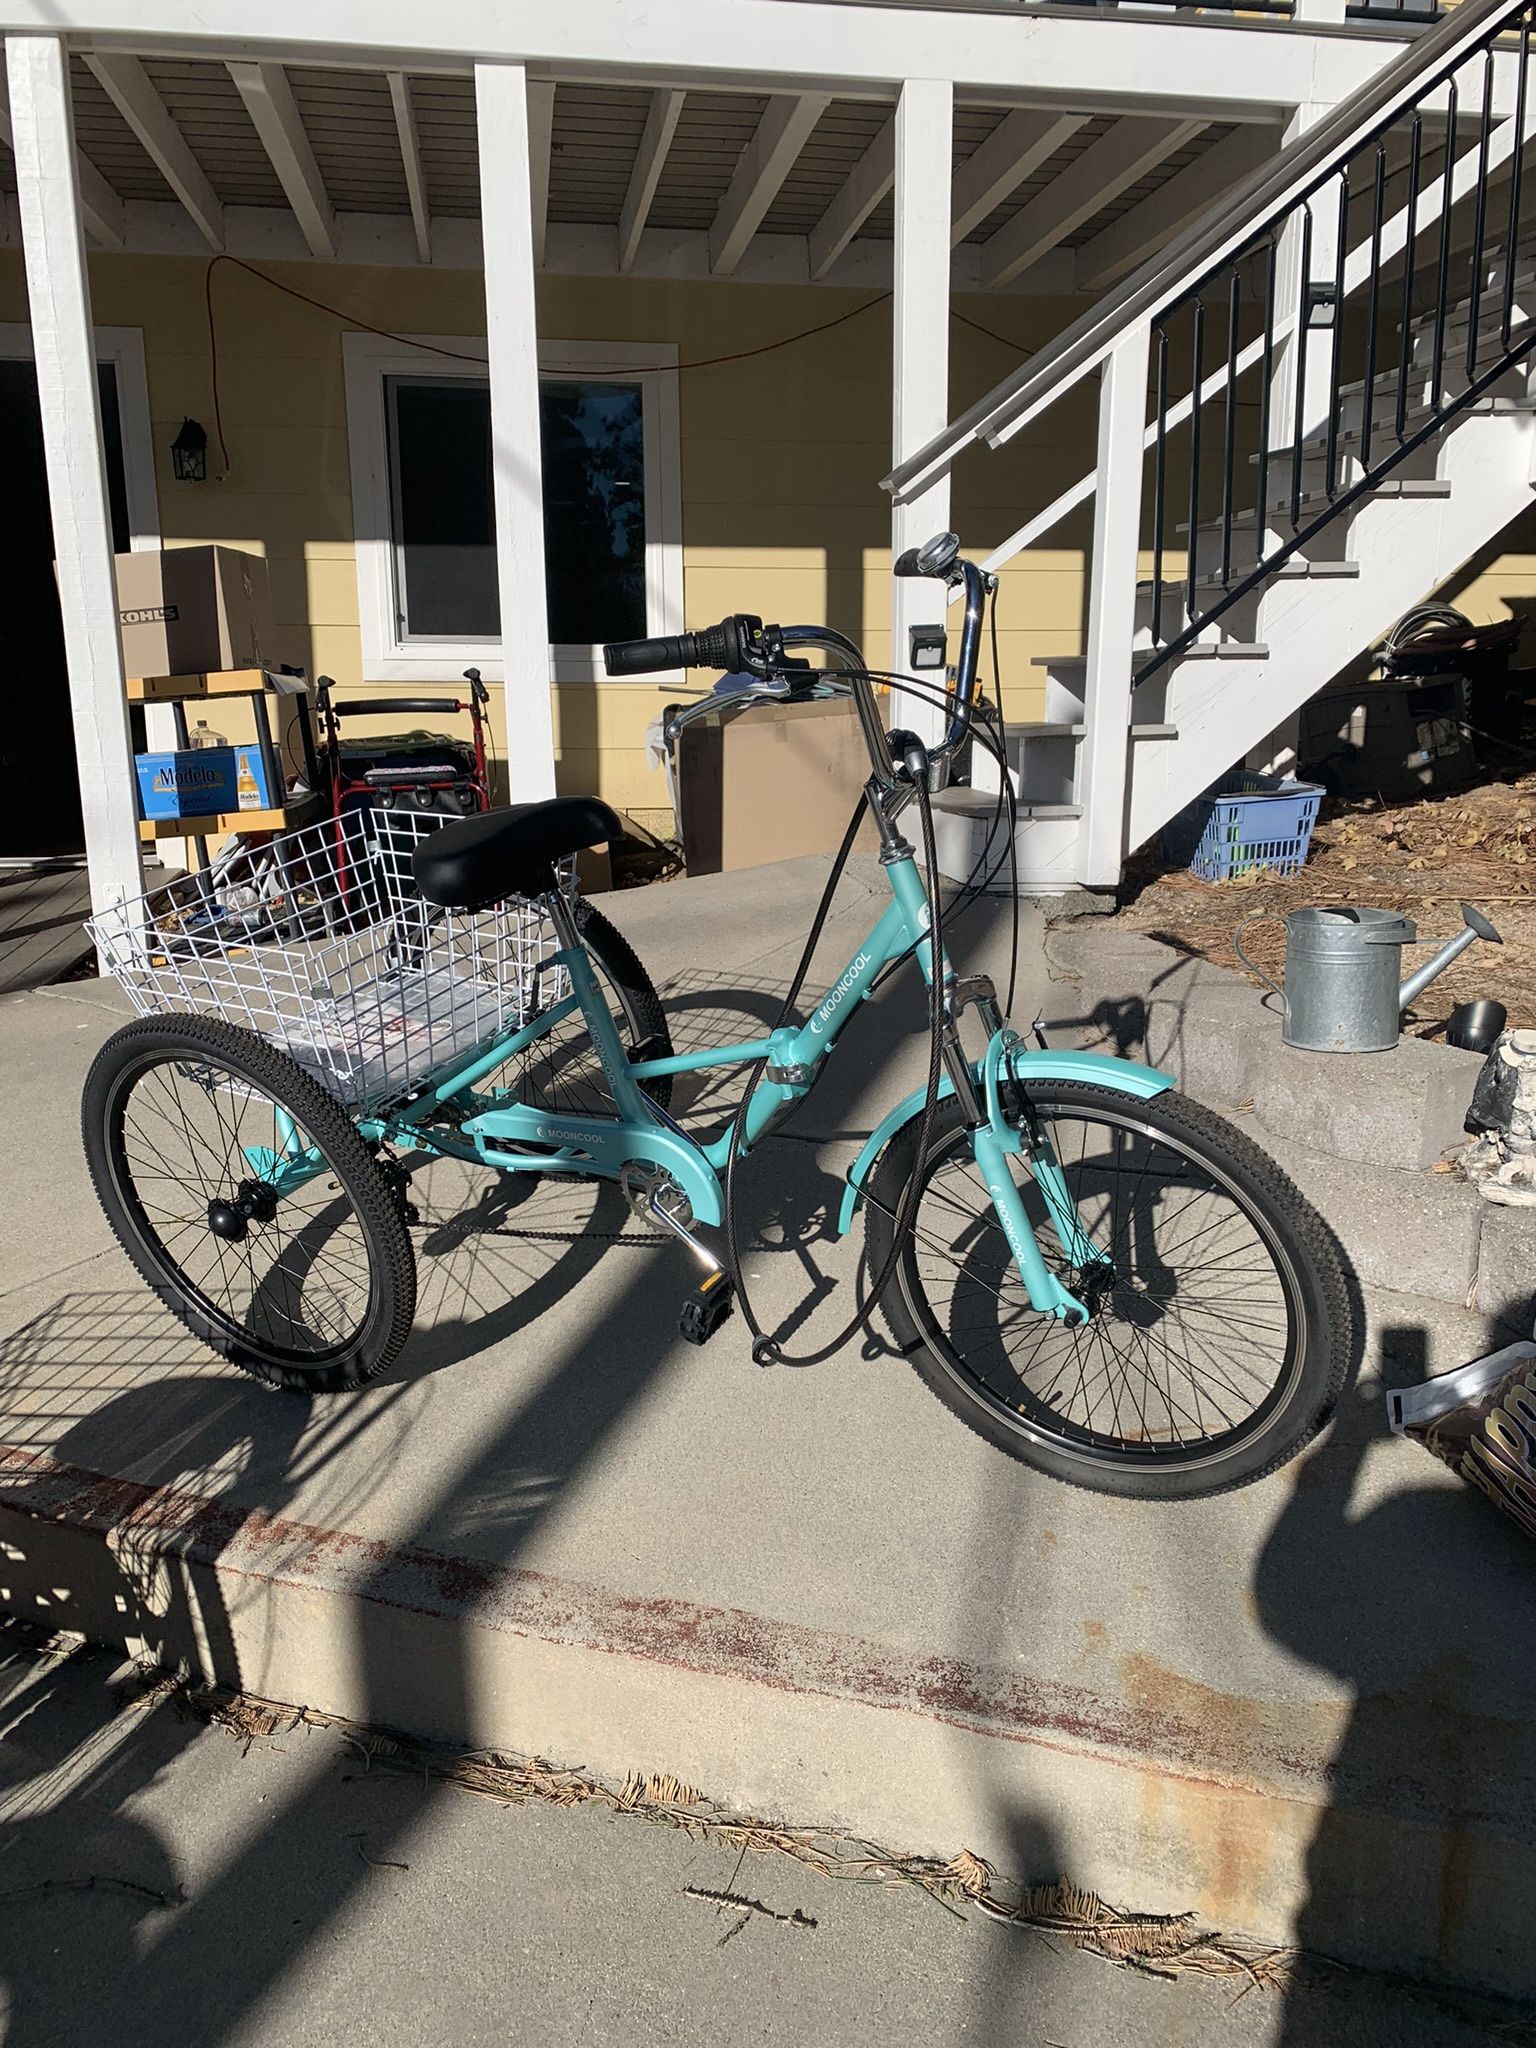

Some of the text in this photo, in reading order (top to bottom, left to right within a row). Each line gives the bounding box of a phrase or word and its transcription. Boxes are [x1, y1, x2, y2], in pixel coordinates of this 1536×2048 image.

[160, 766, 215, 786] Modelo
[818, 952, 872, 1022] MOONCOOL
[588, 1024, 617, 1087] MOONCOOL
[547, 1129, 607, 1144] MOONCOOL
[995, 1199, 1027, 1267] MOONCOOL
